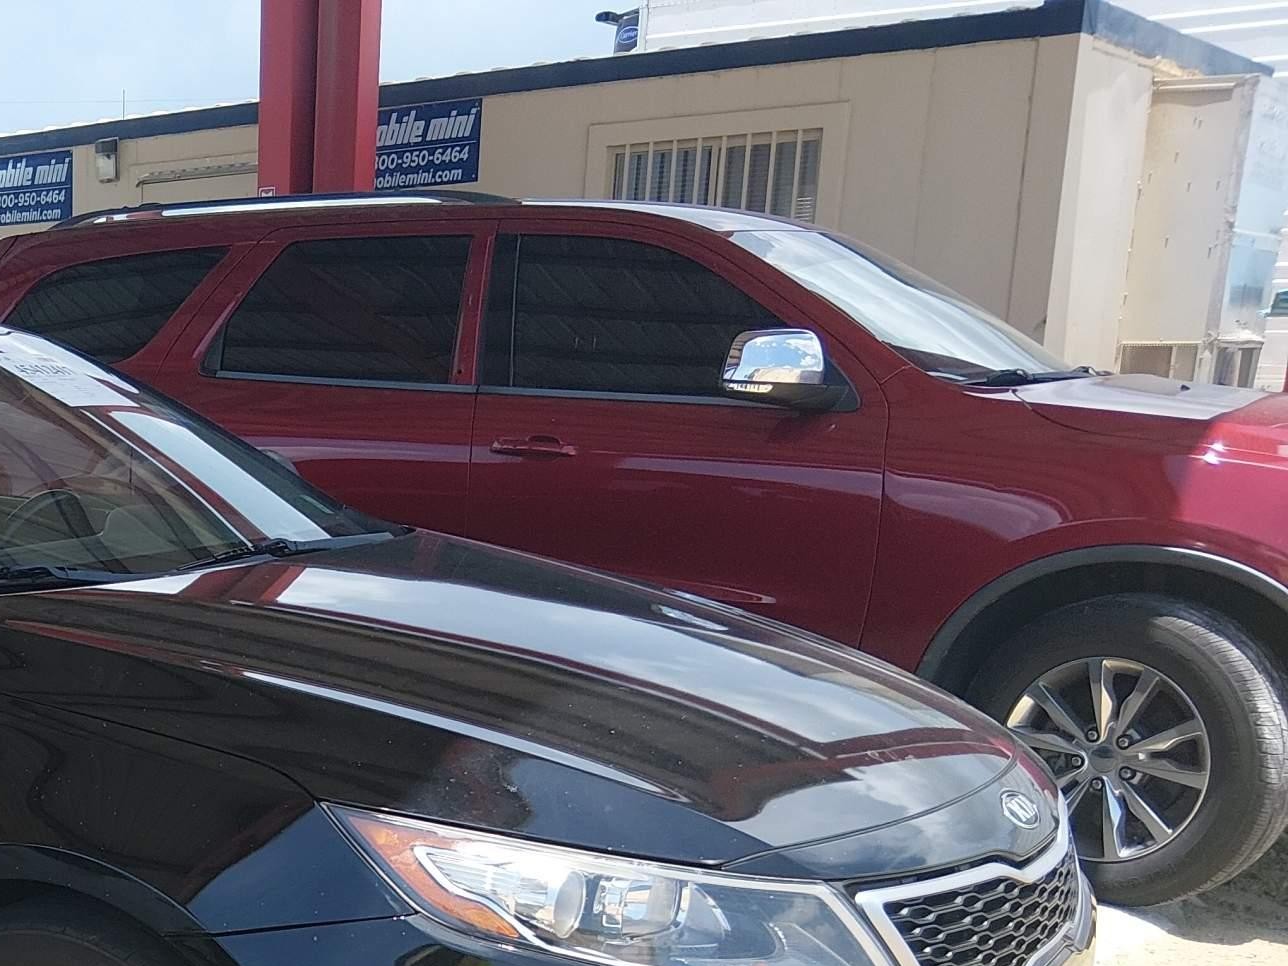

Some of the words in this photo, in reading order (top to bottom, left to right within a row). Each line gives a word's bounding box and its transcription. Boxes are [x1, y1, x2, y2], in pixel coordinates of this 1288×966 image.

[376, 110, 425, 147] obile
[426, 107, 477, 141] mini
[34, 157, 71, 185] mini
[374, 168, 463, 189] obilemini.com
